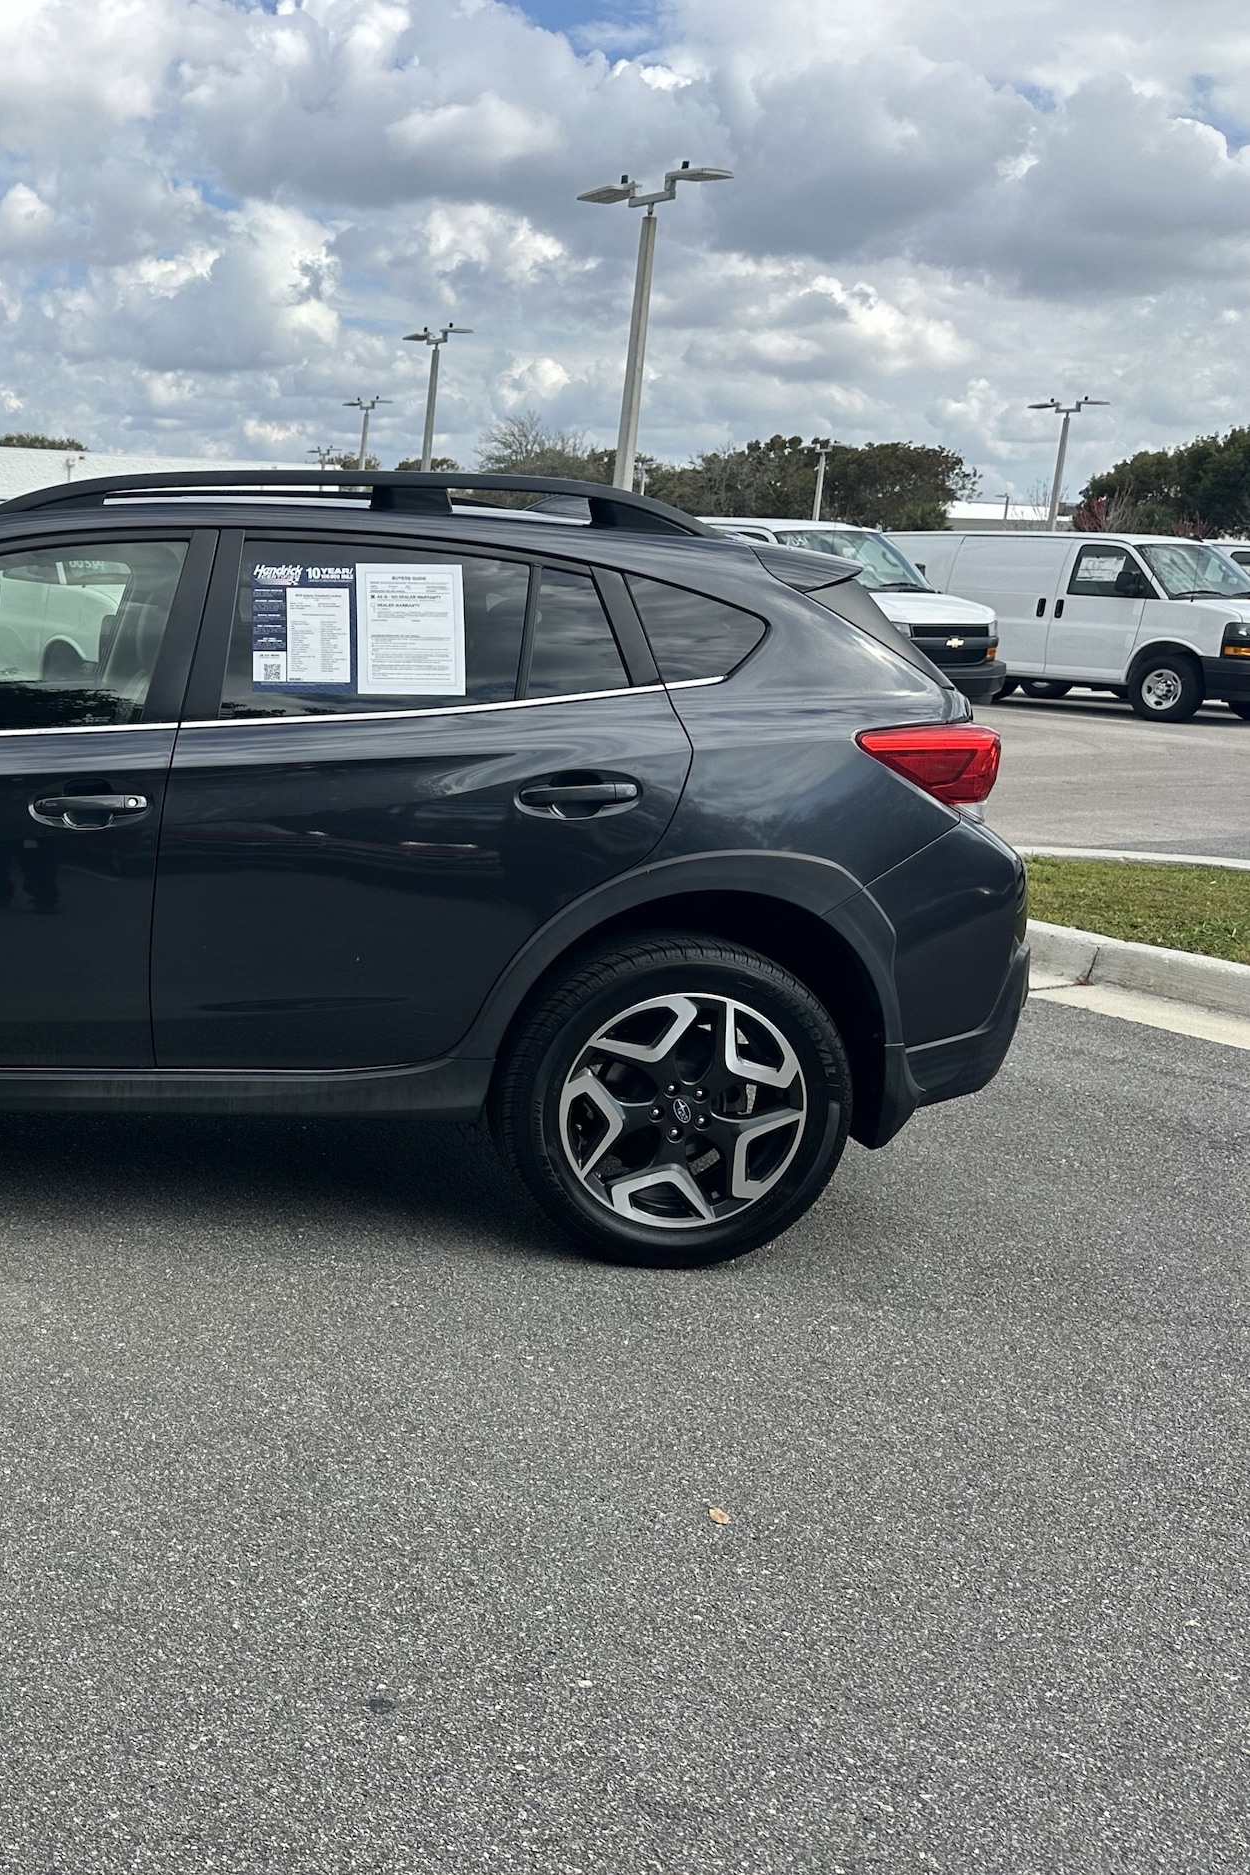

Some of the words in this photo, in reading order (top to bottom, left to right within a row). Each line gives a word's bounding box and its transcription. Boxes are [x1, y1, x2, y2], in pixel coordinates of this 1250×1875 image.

[253, 564, 303, 579] Hendrick
[306, 567, 321, 579] 10
[765, 985, 838, 1078] UNIROYAL
